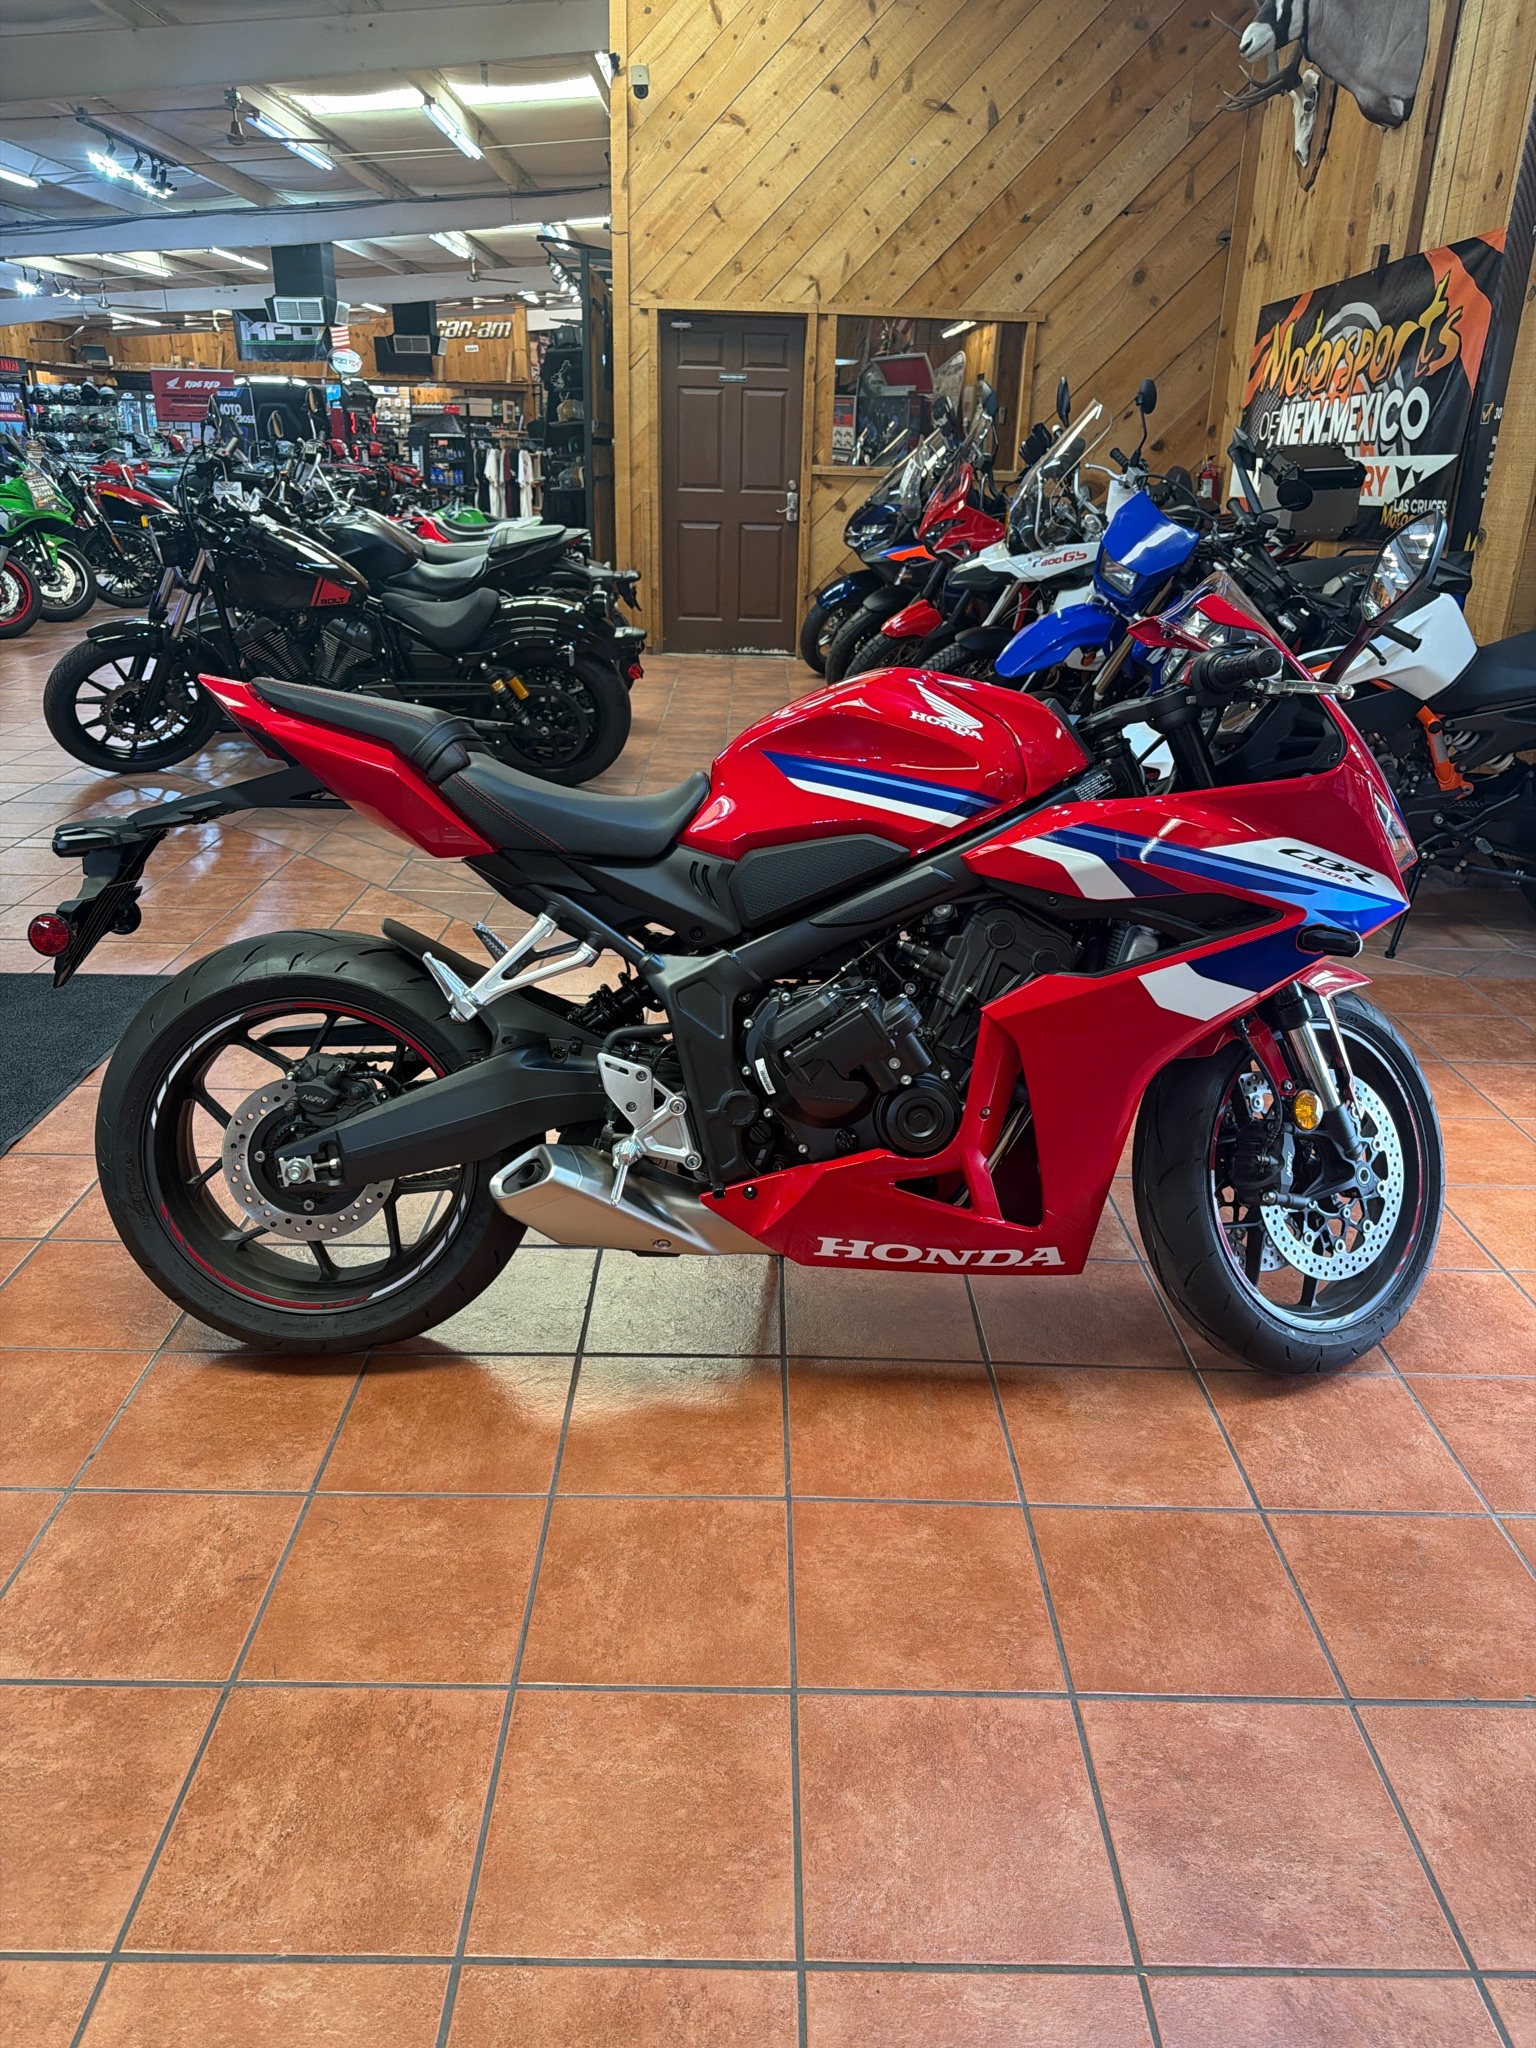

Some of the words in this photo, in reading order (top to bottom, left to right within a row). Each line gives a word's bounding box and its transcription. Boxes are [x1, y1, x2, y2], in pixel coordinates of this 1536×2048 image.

[436, 320, 512, 338] can-am
[1260, 269, 1463, 397] Motorsports
[184, 380, 201, 389] RIDE
[203, 380, 221, 390] RED
[1276, 399, 1330, 446] NEW
[1328, 386, 1430, 444] MEXICO
[1393, 498, 1410, 513] LAS
[321, 597, 345, 605] BOLT
[910, 709, 984, 742] HONDA
[1277, 848, 1376, 888] CBR
[813, 1235, 1066, 1268] HONDA
